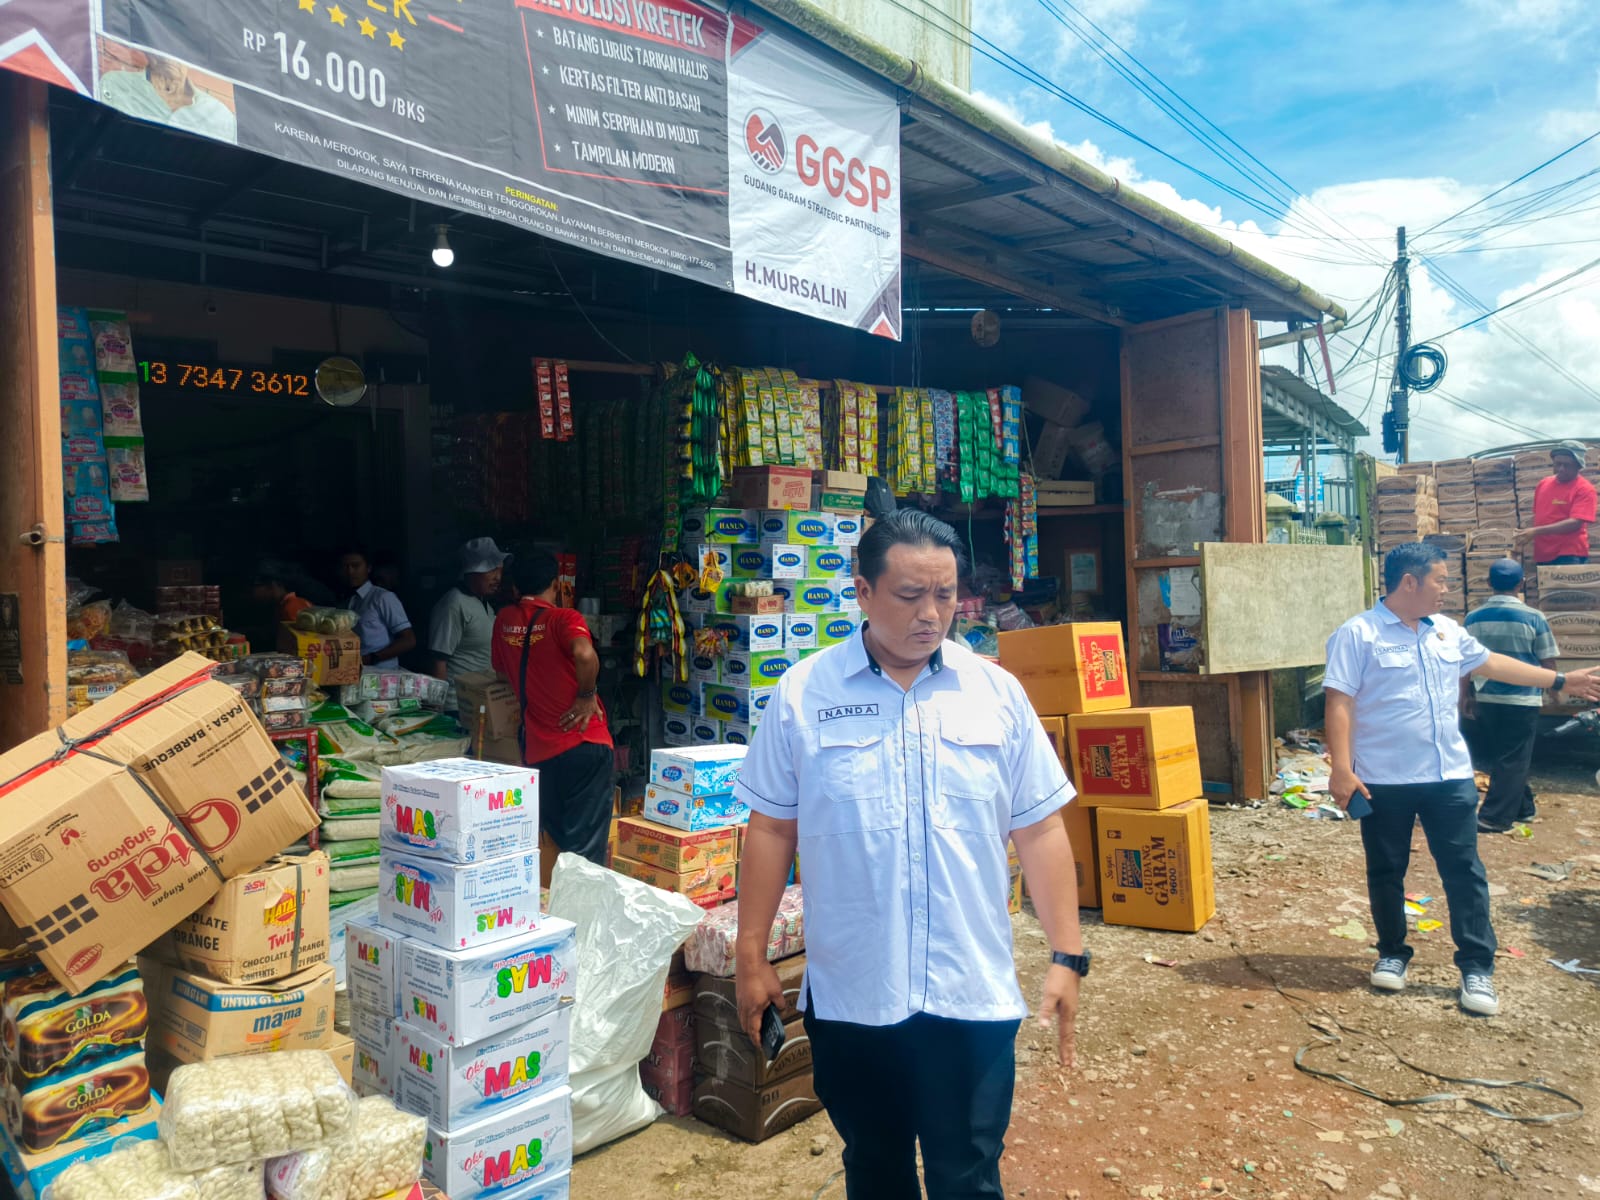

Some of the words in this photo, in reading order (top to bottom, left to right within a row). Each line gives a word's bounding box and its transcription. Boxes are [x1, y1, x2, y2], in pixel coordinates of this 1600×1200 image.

[633, 1, 707, 48] KRETEK
[243, 27, 266, 53] RP
[552, 26, 598, 54] BATANG
[599, 38, 634, 63] LURUS
[635, 48, 678, 74] TARIKAN
[678, 59, 709, 81] HALUS
[273, 31, 387, 108] 16.000
[392, 97, 425, 124] /BKS
[559, 65, 606, 92] KERTAS
[607, 76, 642, 100] FILTER
[644, 85, 667, 105] ANTI
[668, 90, 701, 112] BASAH
[565, 103, 600, 128] MINIM
[602, 112, 655, 139] SERPIHAN
[656, 122, 666, 139] DI
[669, 125, 700, 145] MULUT
[572, 141, 630, 168] TAMPILAN
[632, 150, 676, 174] MODERN
[274, 122, 321, 147] KARENA
[323, 138, 380, 166] MEROKOK,
[383, 158, 408, 174] SAYA
[410, 167, 454, 188] TERKENA
[455, 182, 494, 200] KANKER
[561, 217, 597, 233] LAYANAN
[597, 227, 634, 245] BERHENTI
[634, 239, 670, 256] MEROKOK
[795, 134, 891, 214] GGSP
[337, 159, 385, 181] DILARANG
[386, 174, 427, 194] MENJUAL
[428, 186, 447, 200] DAN
[448, 192, 486, 211] MEMBERI
[488, 205, 518, 222] KEPADA
[518, 215, 545, 231] ORANG
[545, 224, 554, 233] DI
[505, 186, 559, 211] PERINGATAN:
[744, 174, 777, 197] GUDANG
[778, 188, 807, 208] GARAM
[807, 200, 844, 224] STRATEGIC
[845, 215, 891, 240] PARTNERSHIP
[745, 260, 848, 310] H.MURSALIN
[176, 363, 243, 391] 7347
[251, 373, 310, 396] 3612
[719, 522, 745, 530] HANUN
[800, 524, 824, 532] HANUN
[807, 592, 830, 600] HANUN
[829, 624, 851, 633] HANUN
[763, 663, 788, 672] HANUN
[1090, 640, 1104, 692] GARAM
[213, 703, 244, 728] RASA
[825, 706, 874, 719] NANDA
[142, 727, 208, 772] BARBEQUE
[1120, 734, 1132, 789] GARAM
[488, 787, 523, 811] MAS
[395, 804, 437, 841] MAS
[87, 825, 158, 873] singkong
[89, 798, 242, 903] Qtela
[1168, 848, 1177, 860] 12
[1144, 843, 1154, 896] GUDANG
[1154, 835, 1169, 907] GARAM
[1169, 868, 1178, 896] 9600
[151, 882, 185, 908] Ringan
[395, 872, 431, 913] MAS
[187, 913, 229, 931] COLATE
[476, 906, 513, 933] MAS
[175, 929, 220, 952] ORANGE
[242, 950, 288, 969] CHOCOLATE
[298, 939, 325, 955] ORANGE
[267, 928, 305, 951] Twis
[357, 941, 380, 966] MAS
[240, 969, 278, 982] CONTENTS:
[496, 954, 552, 999] MAS
[220, 995, 258, 1009] UNTUK
[259, 994, 272, 1005] GT
[413, 996, 437, 1024] MAS
[65, 1010, 112, 1035] GOLDA
[253, 1006, 303, 1034] mama
[409, 1044, 434, 1074] MAS
[484, 1051, 541, 1097] MAS
[66, 1084, 113, 1110] GOLDA
[483, 1138, 543, 1187] MAS
